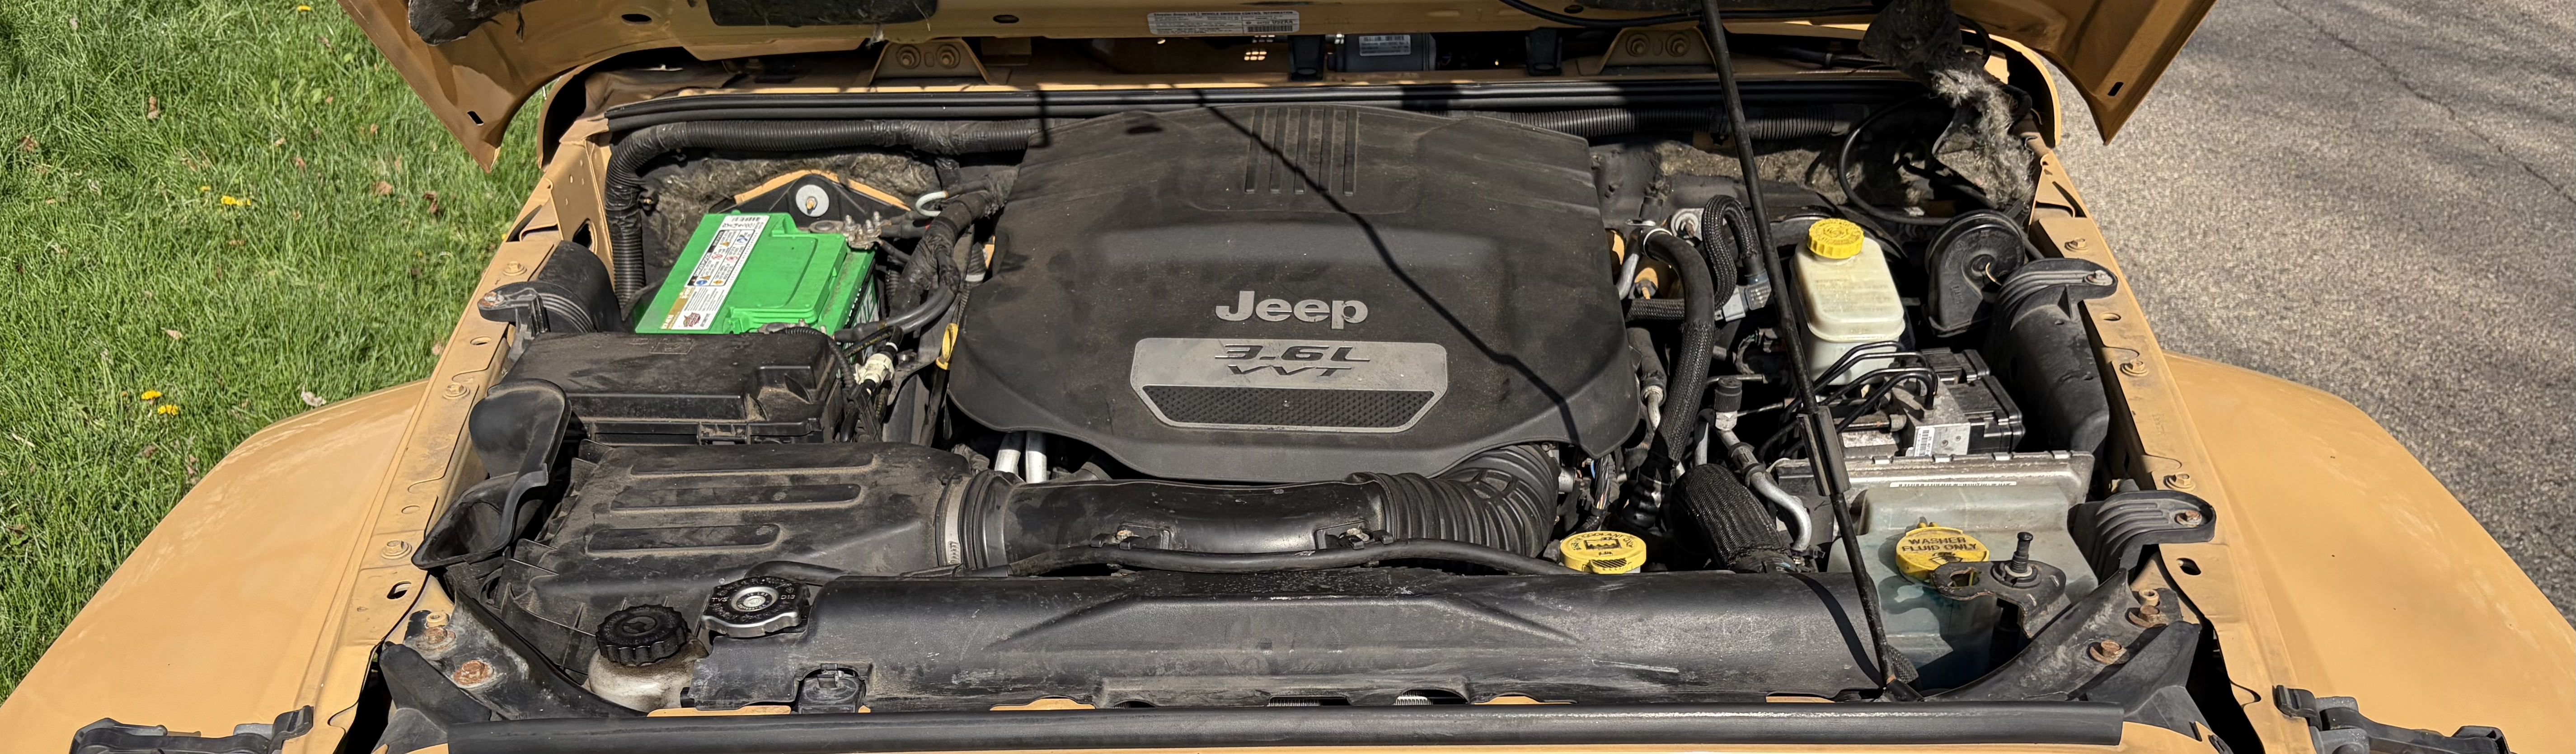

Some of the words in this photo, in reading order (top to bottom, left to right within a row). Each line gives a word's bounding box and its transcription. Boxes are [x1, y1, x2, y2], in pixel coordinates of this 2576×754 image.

[1215, 291, 1368, 329] Jeep
[1215, 344, 1370, 362] 3.6L
[1228, 364, 1352, 376] VVT
